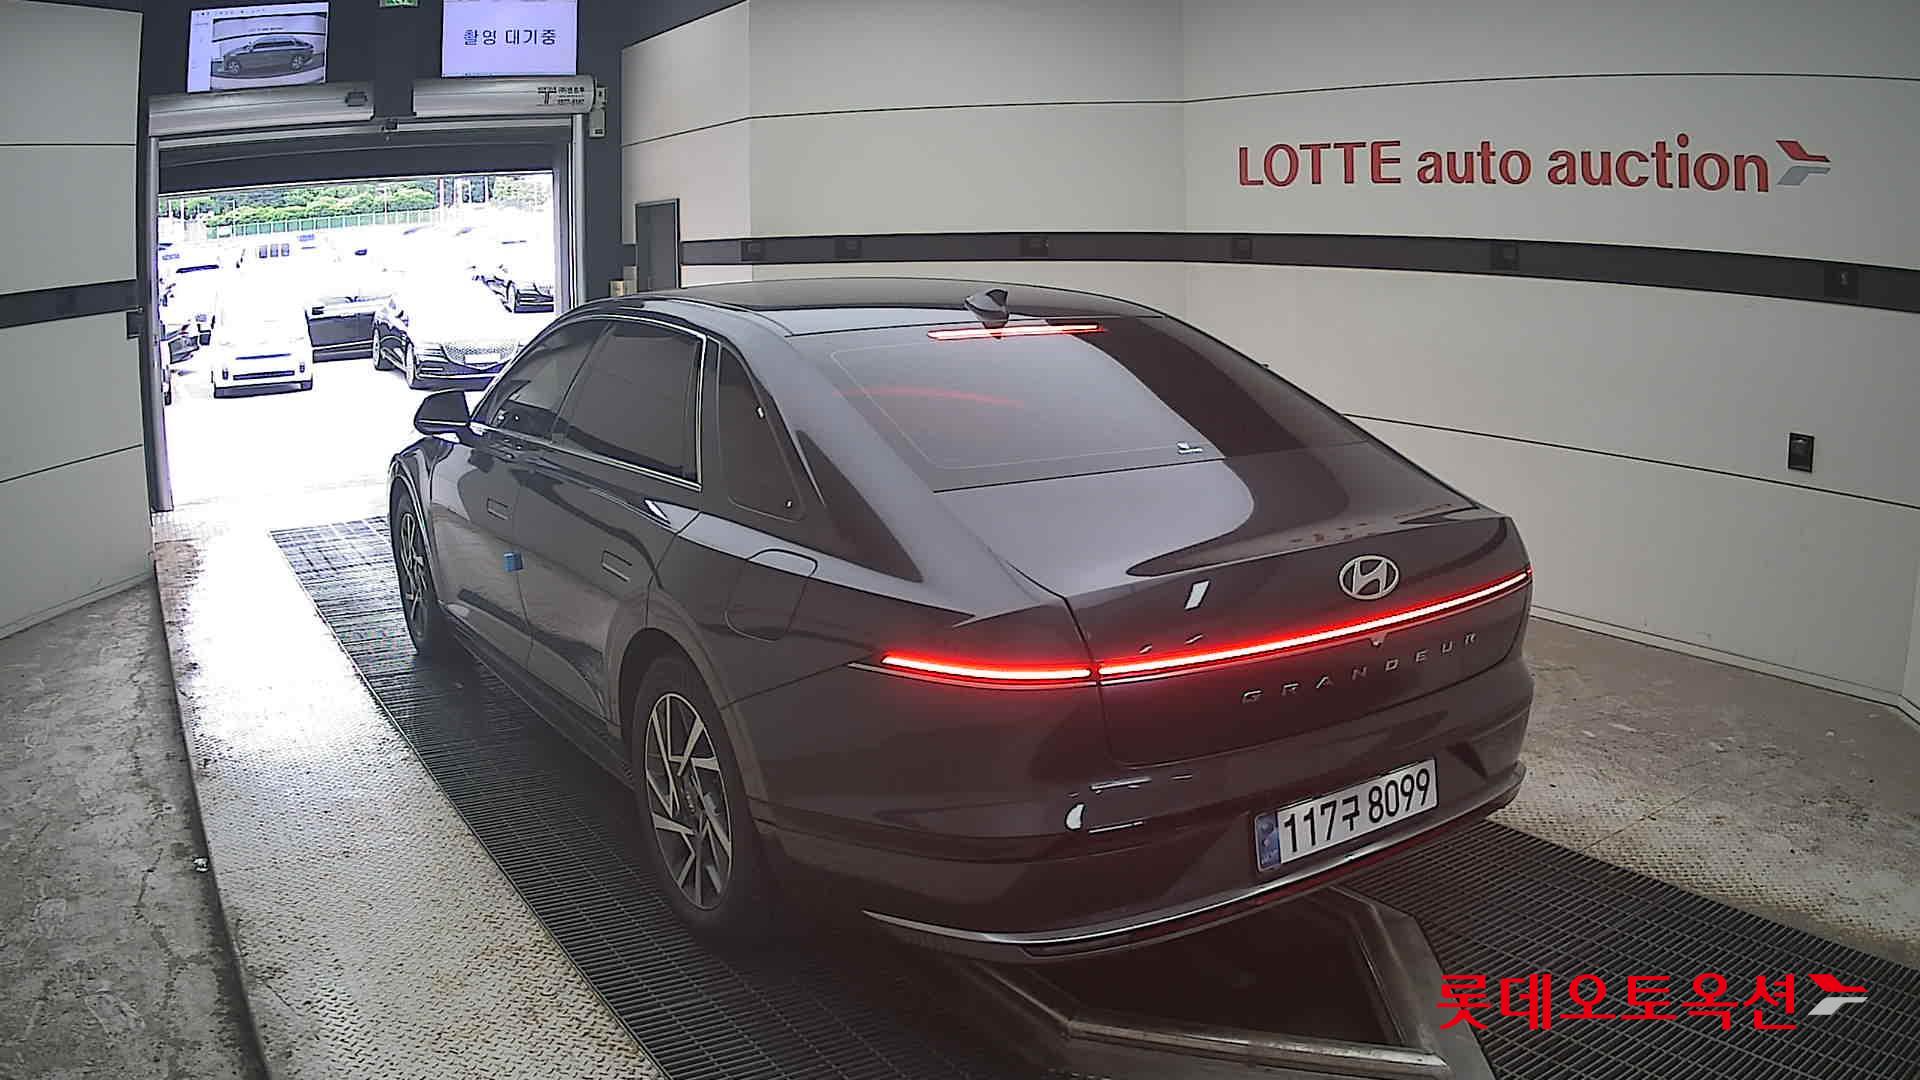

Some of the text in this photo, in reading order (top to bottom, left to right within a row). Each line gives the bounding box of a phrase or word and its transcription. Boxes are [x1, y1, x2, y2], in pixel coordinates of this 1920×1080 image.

[464, 29, 556, 46] 촬영 대기중
[1238, 133, 1769, 193] LOTTE auto auction
[1241, 632, 1477, 704] GRANDEUR
[1283, 768, 1430, 853] 117구 8099
